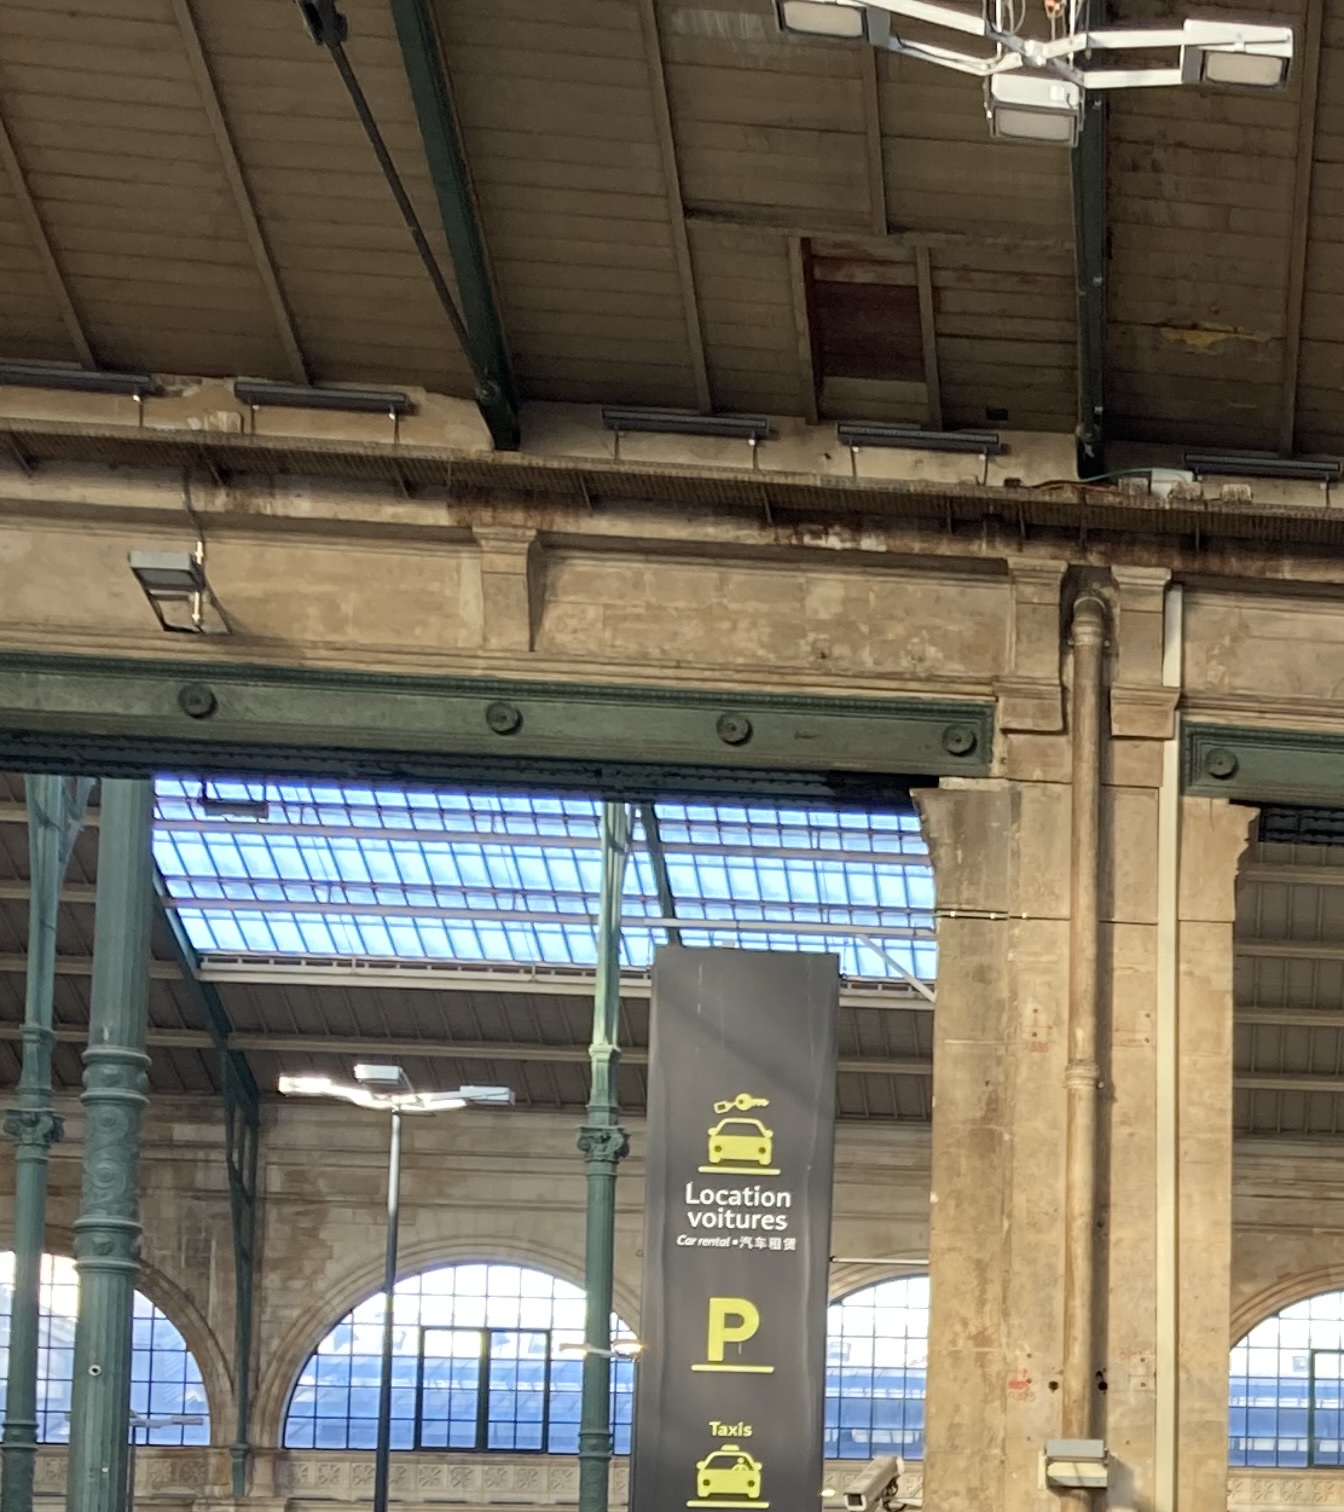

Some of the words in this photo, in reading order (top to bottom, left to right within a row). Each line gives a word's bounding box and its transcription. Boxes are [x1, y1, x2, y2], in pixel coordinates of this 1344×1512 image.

[685, 1181, 791, 1208] Location
[687, 1207, 788, 1230] voitures
[676, 1234, 698, 1246] Car
[698, 1236, 731, 1247] rental
[707, 1297, 760, 1362] P
[708, 1420, 752, 1437] Taxis
